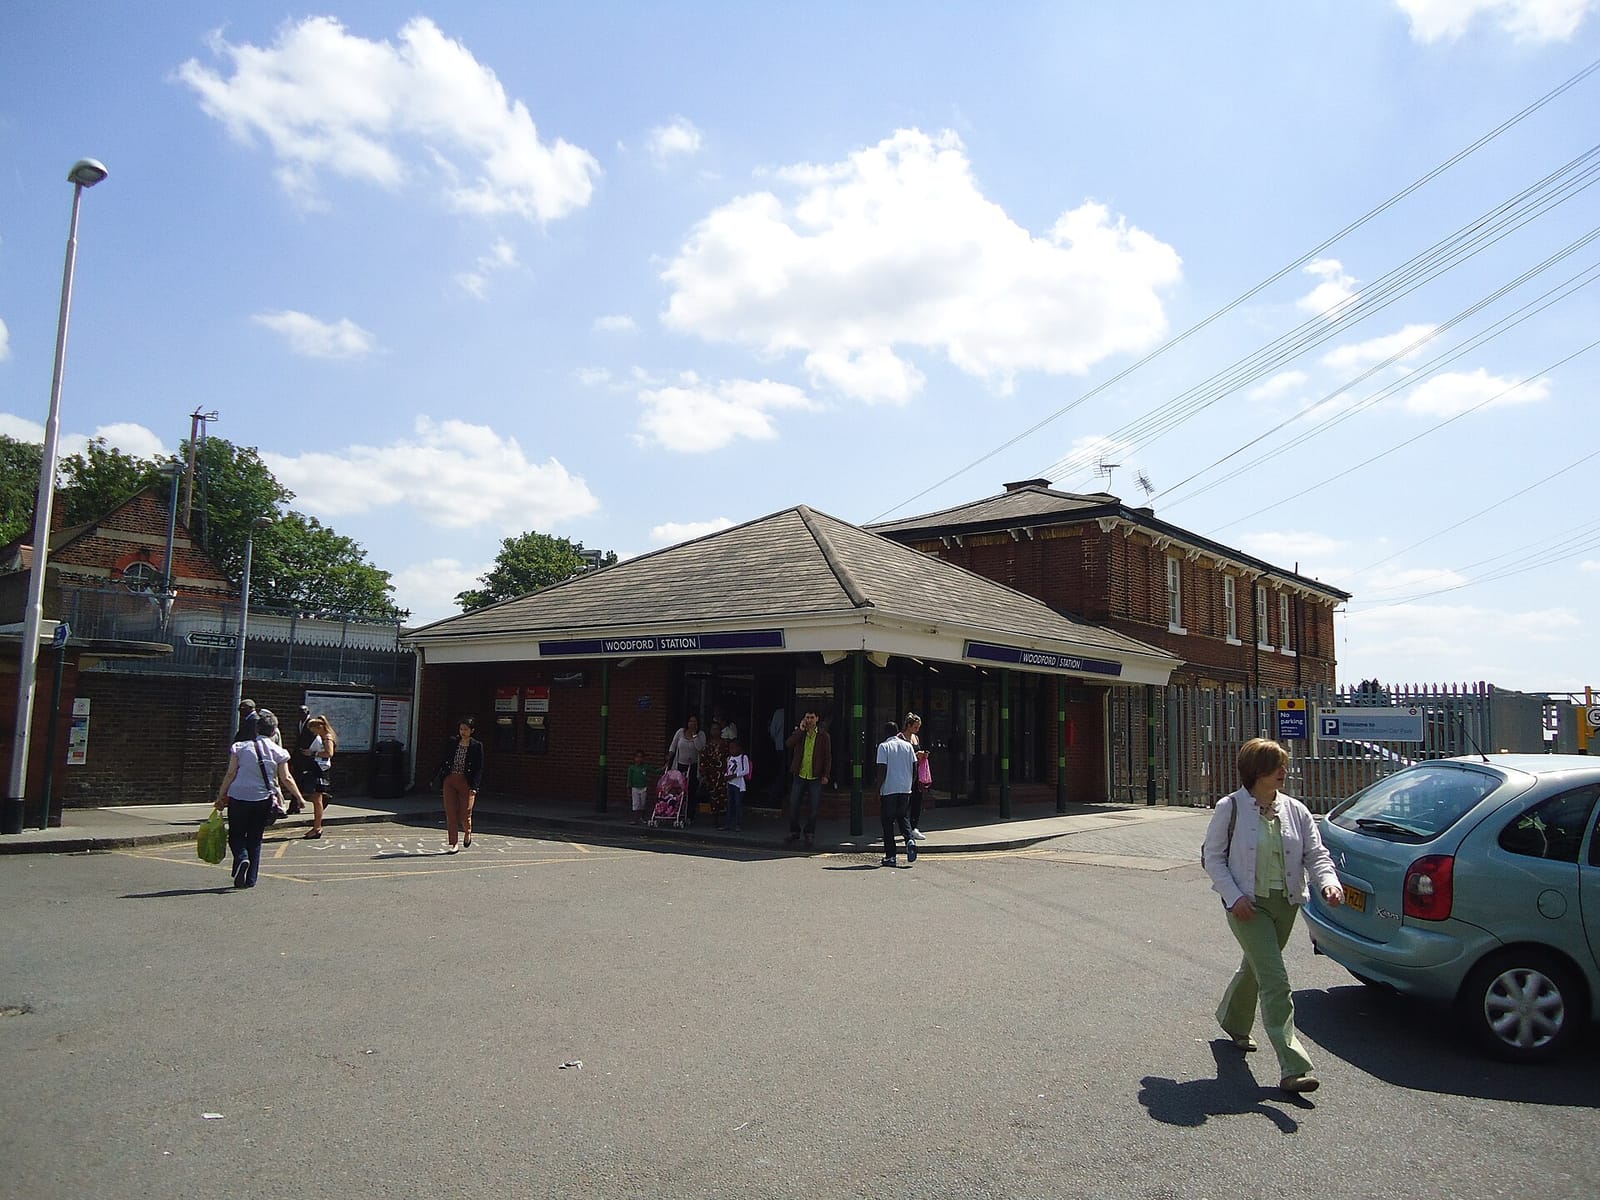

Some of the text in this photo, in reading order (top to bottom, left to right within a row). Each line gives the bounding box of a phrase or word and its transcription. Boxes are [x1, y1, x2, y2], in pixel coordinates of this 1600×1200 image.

[605, 638, 697, 651] WOODFORD STATION
[1023, 652, 1081, 669] WOODFORD STATION
[1325, 719, 1337, 734] P
